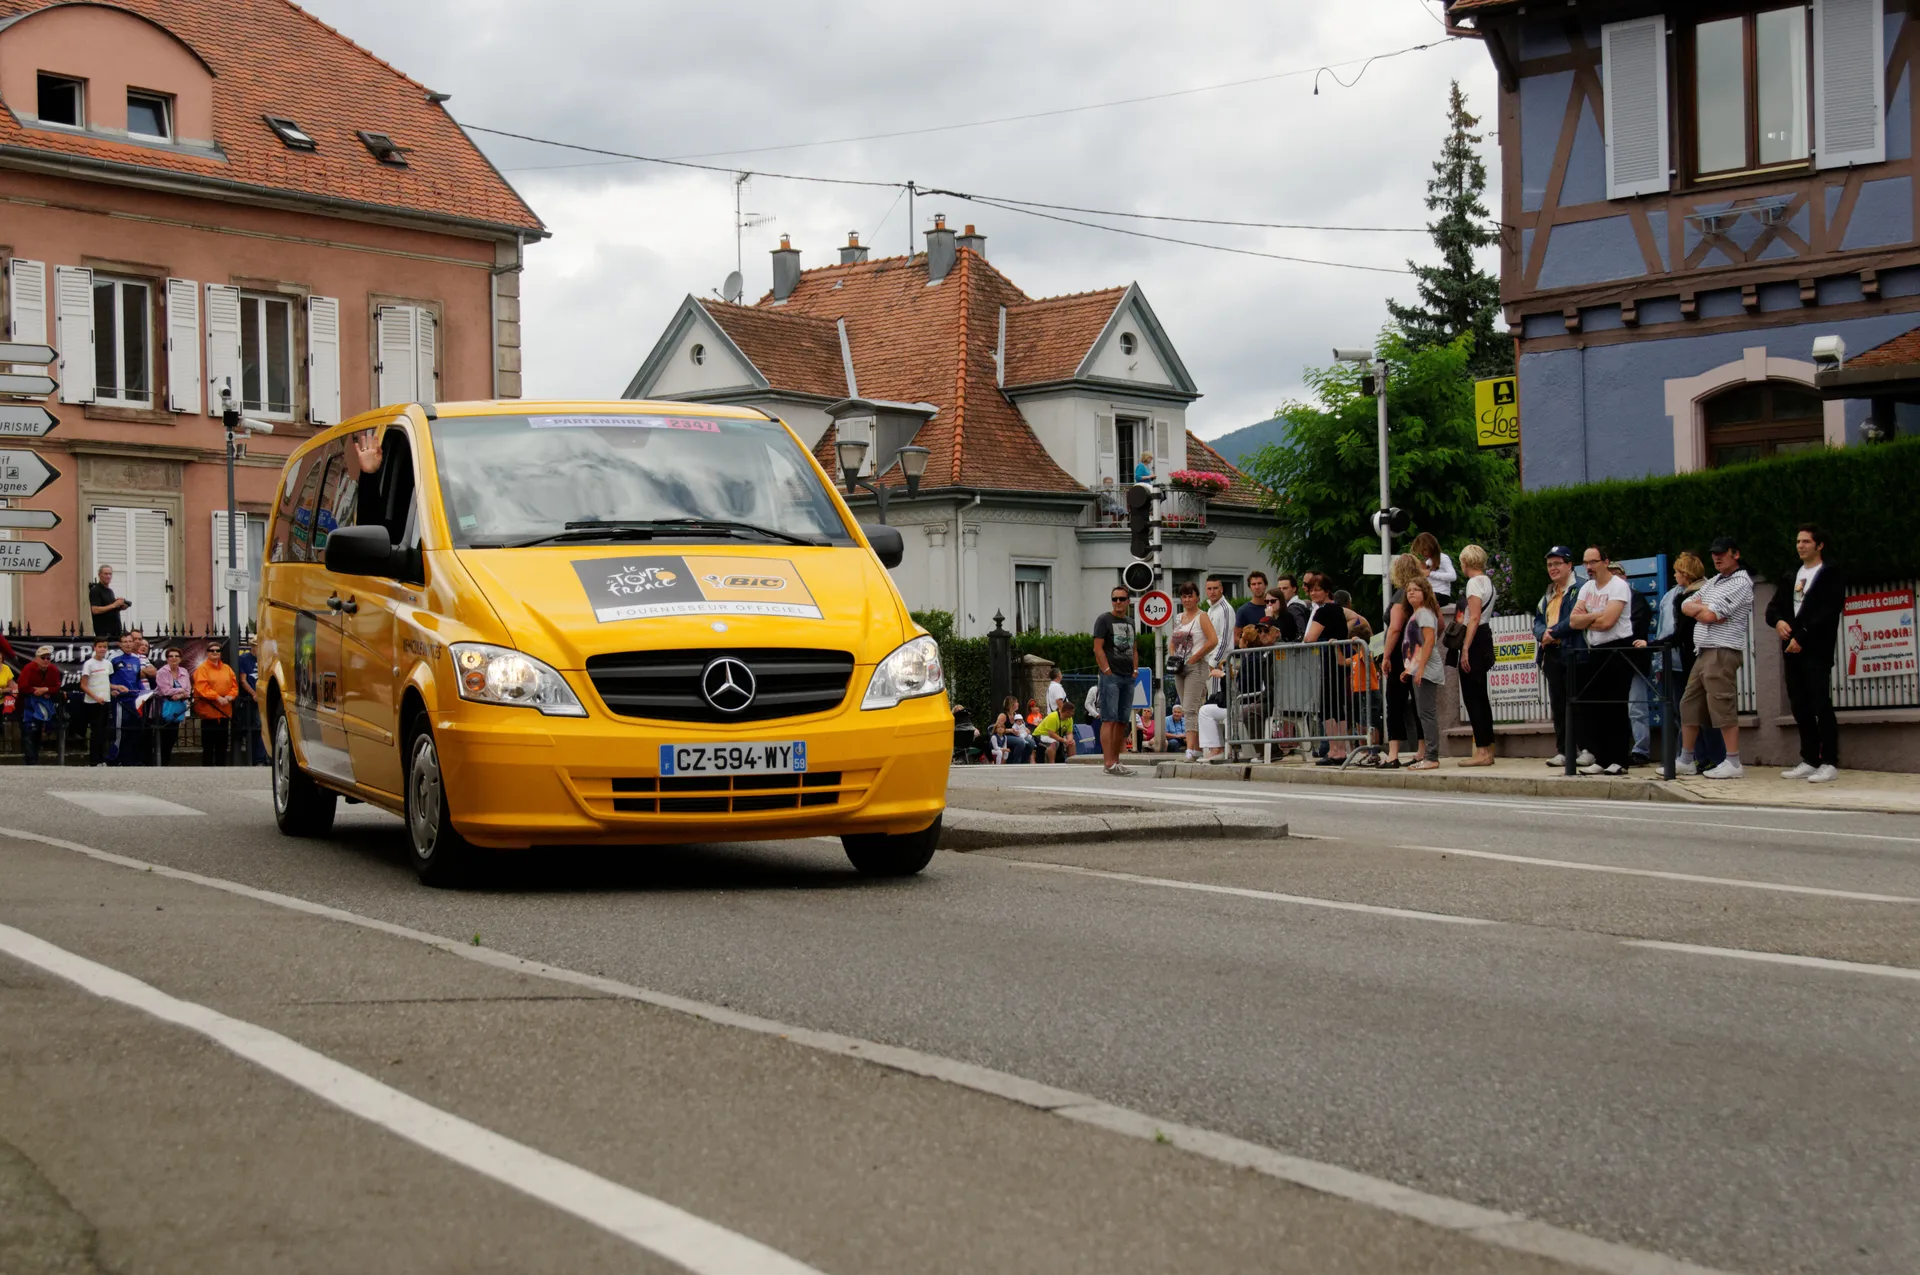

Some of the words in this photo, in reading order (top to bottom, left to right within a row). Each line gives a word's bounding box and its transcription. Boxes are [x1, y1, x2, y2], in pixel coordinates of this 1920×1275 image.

[553, 418, 646, 426] PARTENAIRE
[670, 419, 713, 431] 2347
[0, 557, 41, 568] TISANE
[616, 604, 729, 617] FOURNISSEUR
[736, 604, 804, 615] OFFICIEL
[1499, 644, 1527, 656] ISOREV
[1491, 674, 1500, 687] 03
[1500, 673, 1509, 686] 89
[1511, 672, 1519, 685] 48
[1520, 672, 1529, 685] 92
[1530, 671, 1538, 684] 91
[677, 746, 792, 771] CZ-594-WY
[794, 758, 806, 770] 59
